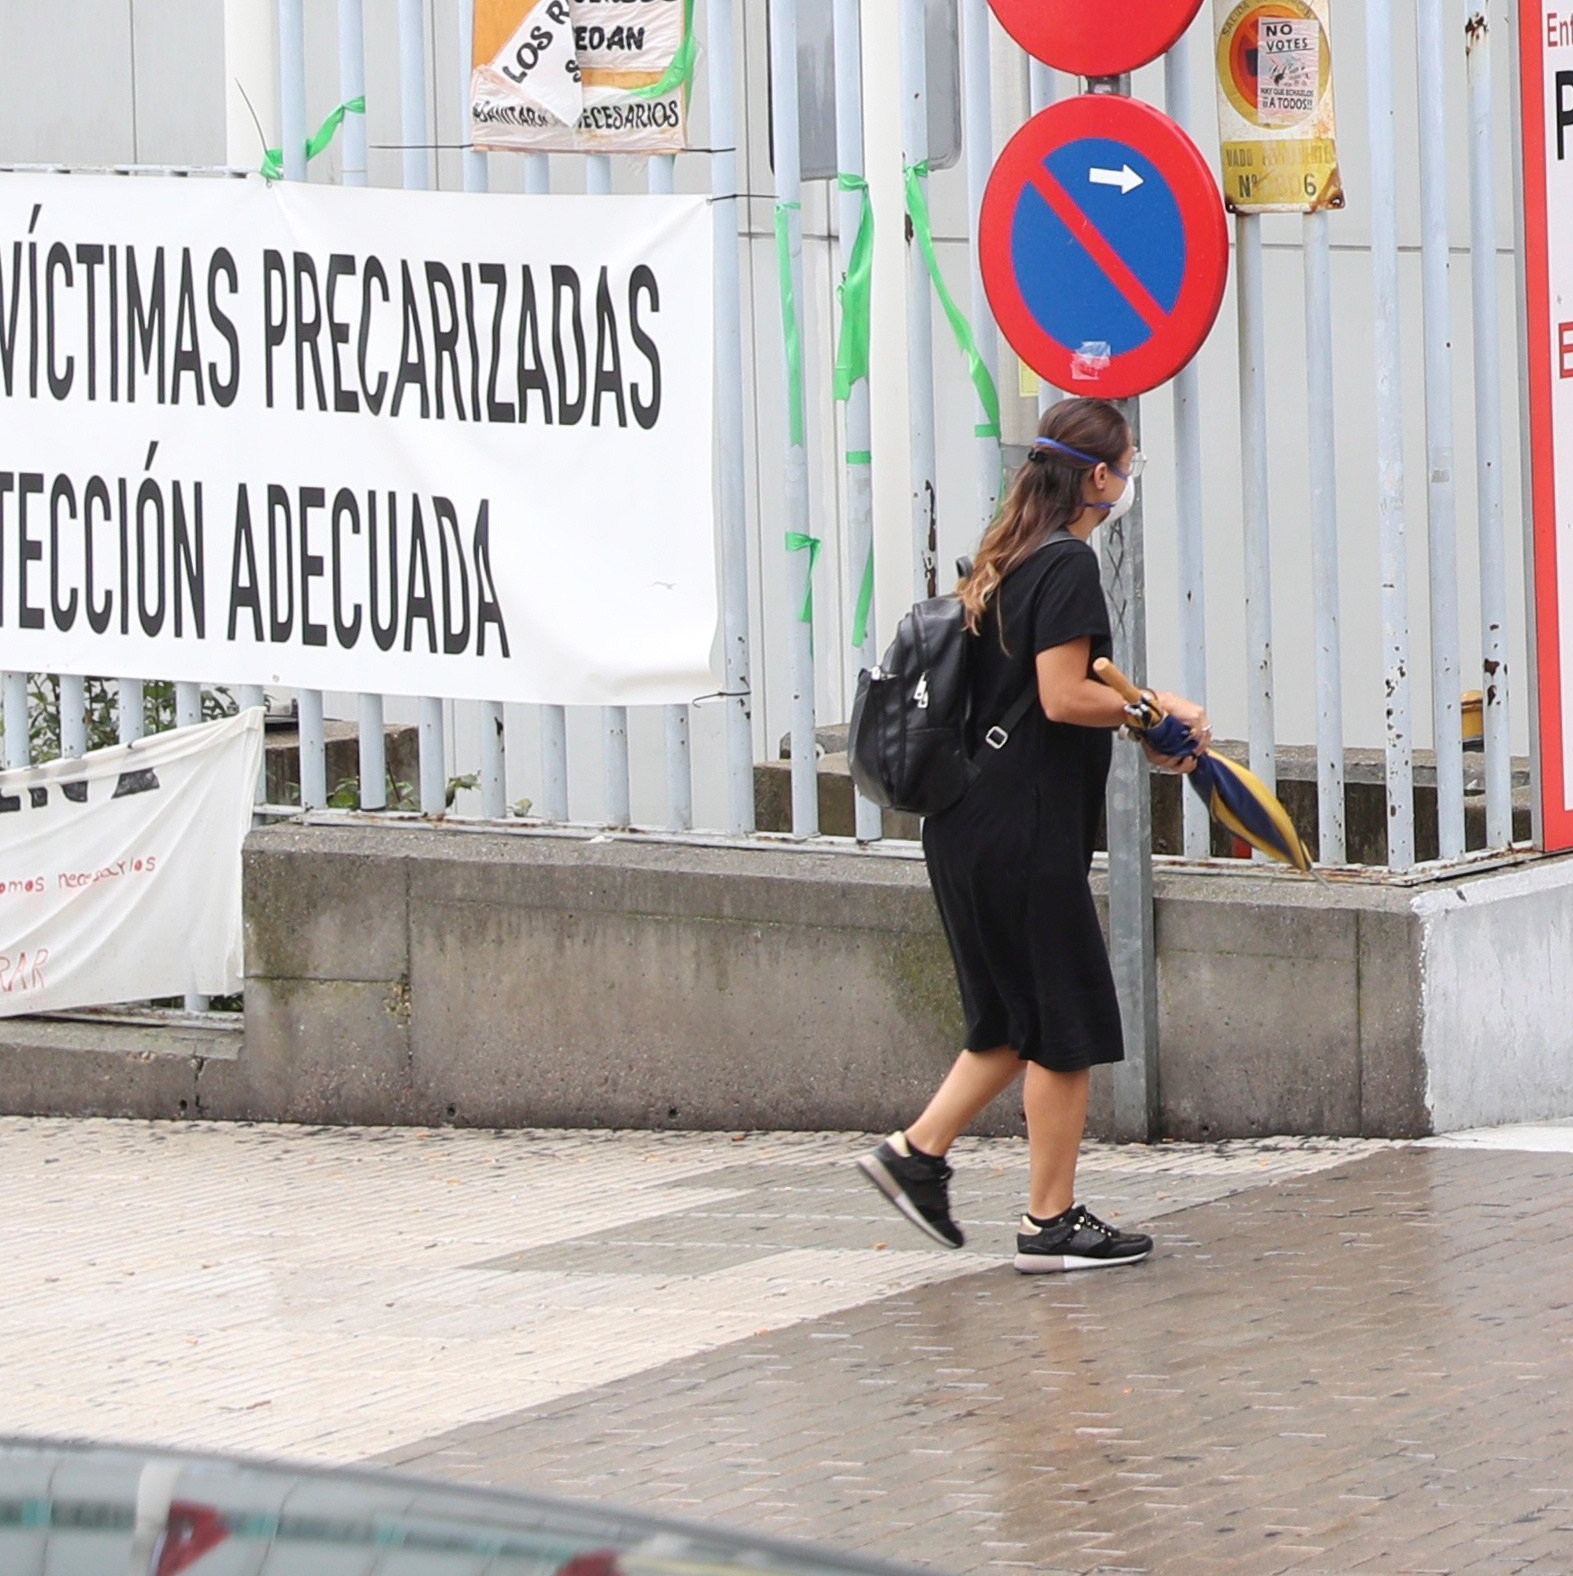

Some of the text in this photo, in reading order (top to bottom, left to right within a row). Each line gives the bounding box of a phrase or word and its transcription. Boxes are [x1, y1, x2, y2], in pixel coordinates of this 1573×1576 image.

[502, 25, 553, 84] LOS
[1266, 24, 1293, 37] NO
[1266, 38, 1308, 51] VOTES
[0, 204, 662, 431] VÍCTIMAS PRECARIZADAS
[226, 482, 511, 660] ADECUADA
